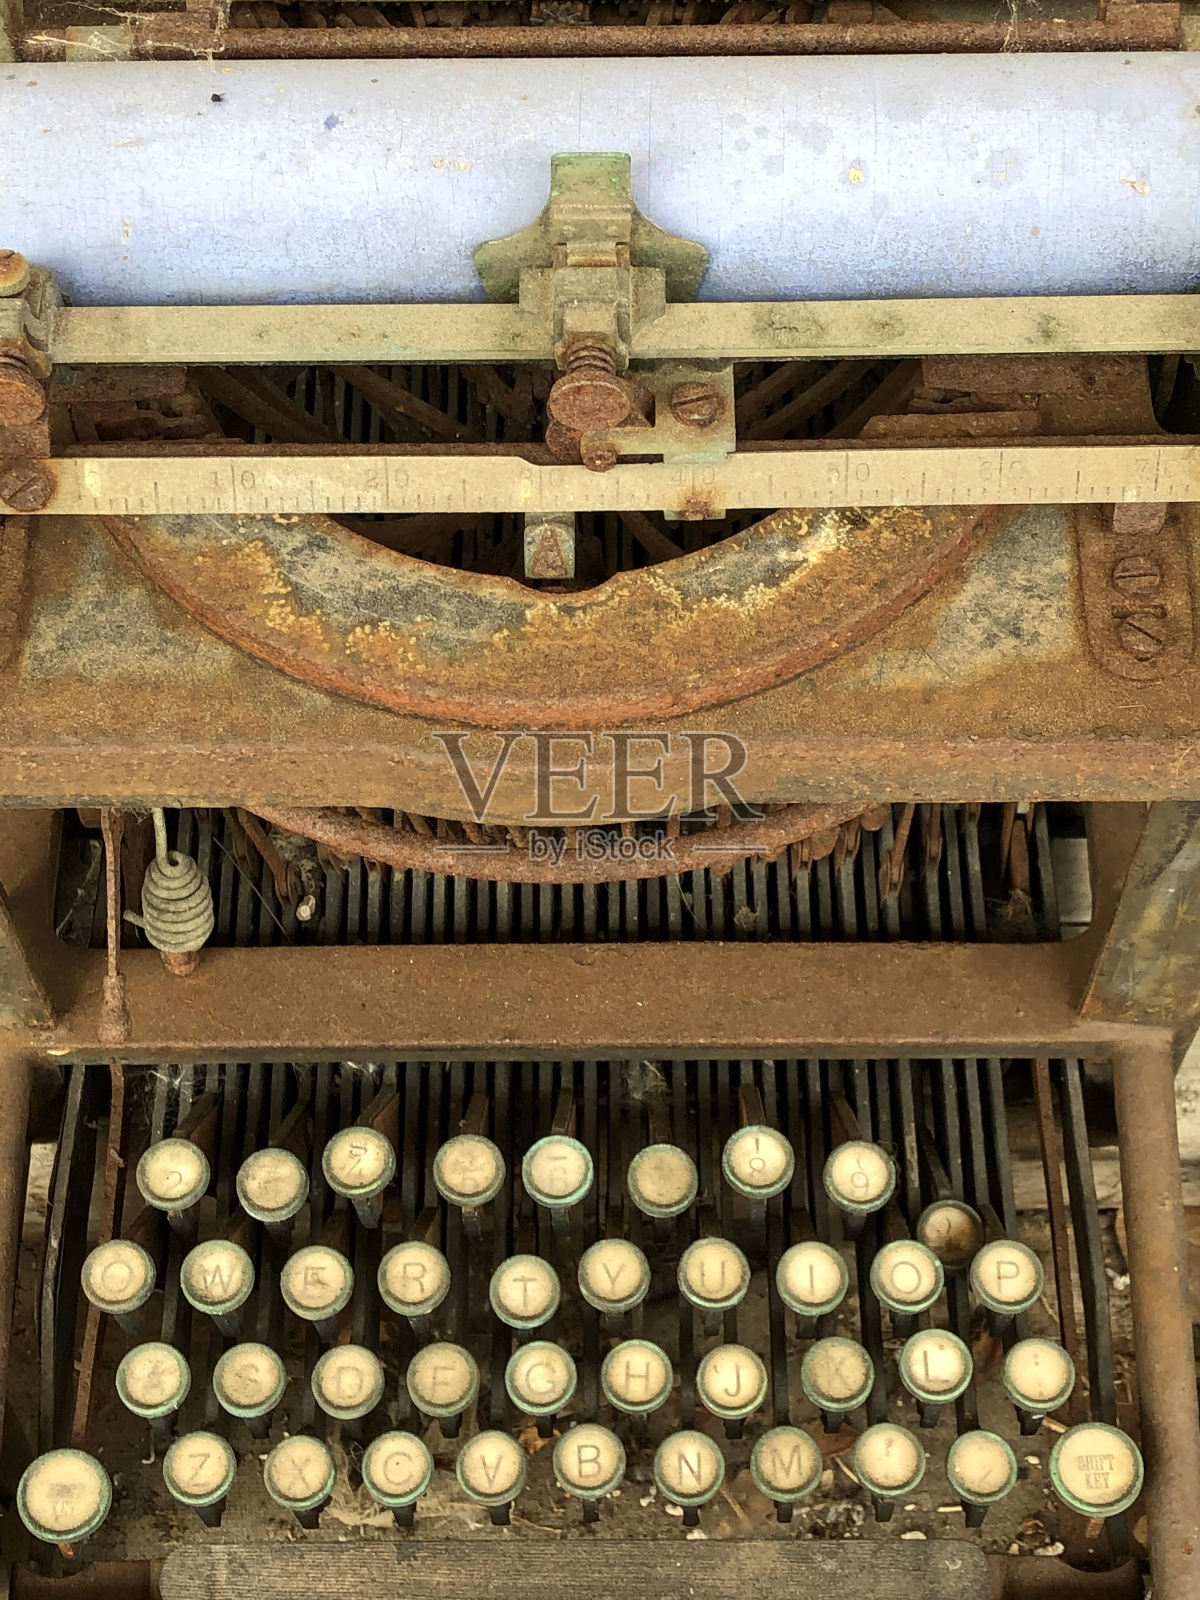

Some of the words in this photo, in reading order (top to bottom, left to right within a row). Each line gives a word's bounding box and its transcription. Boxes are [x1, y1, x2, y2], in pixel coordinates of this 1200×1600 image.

[200, 1263, 237, 1293] W
[402, 1261, 427, 1294] R
[511, 1274, 538, 1310] T
[601, 1262, 626, 1295] Y
[699, 1260, 727, 1296] U
[891, 1261, 922, 1295] O
[997, 1260, 1021, 1294] P
[337, 1365, 364, 1399] D
[432, 1365, 456, 1399] F
[525, 1361, 557, 1397] G
[625, 1360, 651, 1395] H
[923, 1349, 952, 1383] L
[189, 1452, 212, 1487] Z
[383, 1451, 413, 1487] C
[480, 1454, 504, 1487] V
[578, 1444, 601, 1478] B
[678, 1450, 702, 1486] N
[771, 1444, 803, 1480] M
